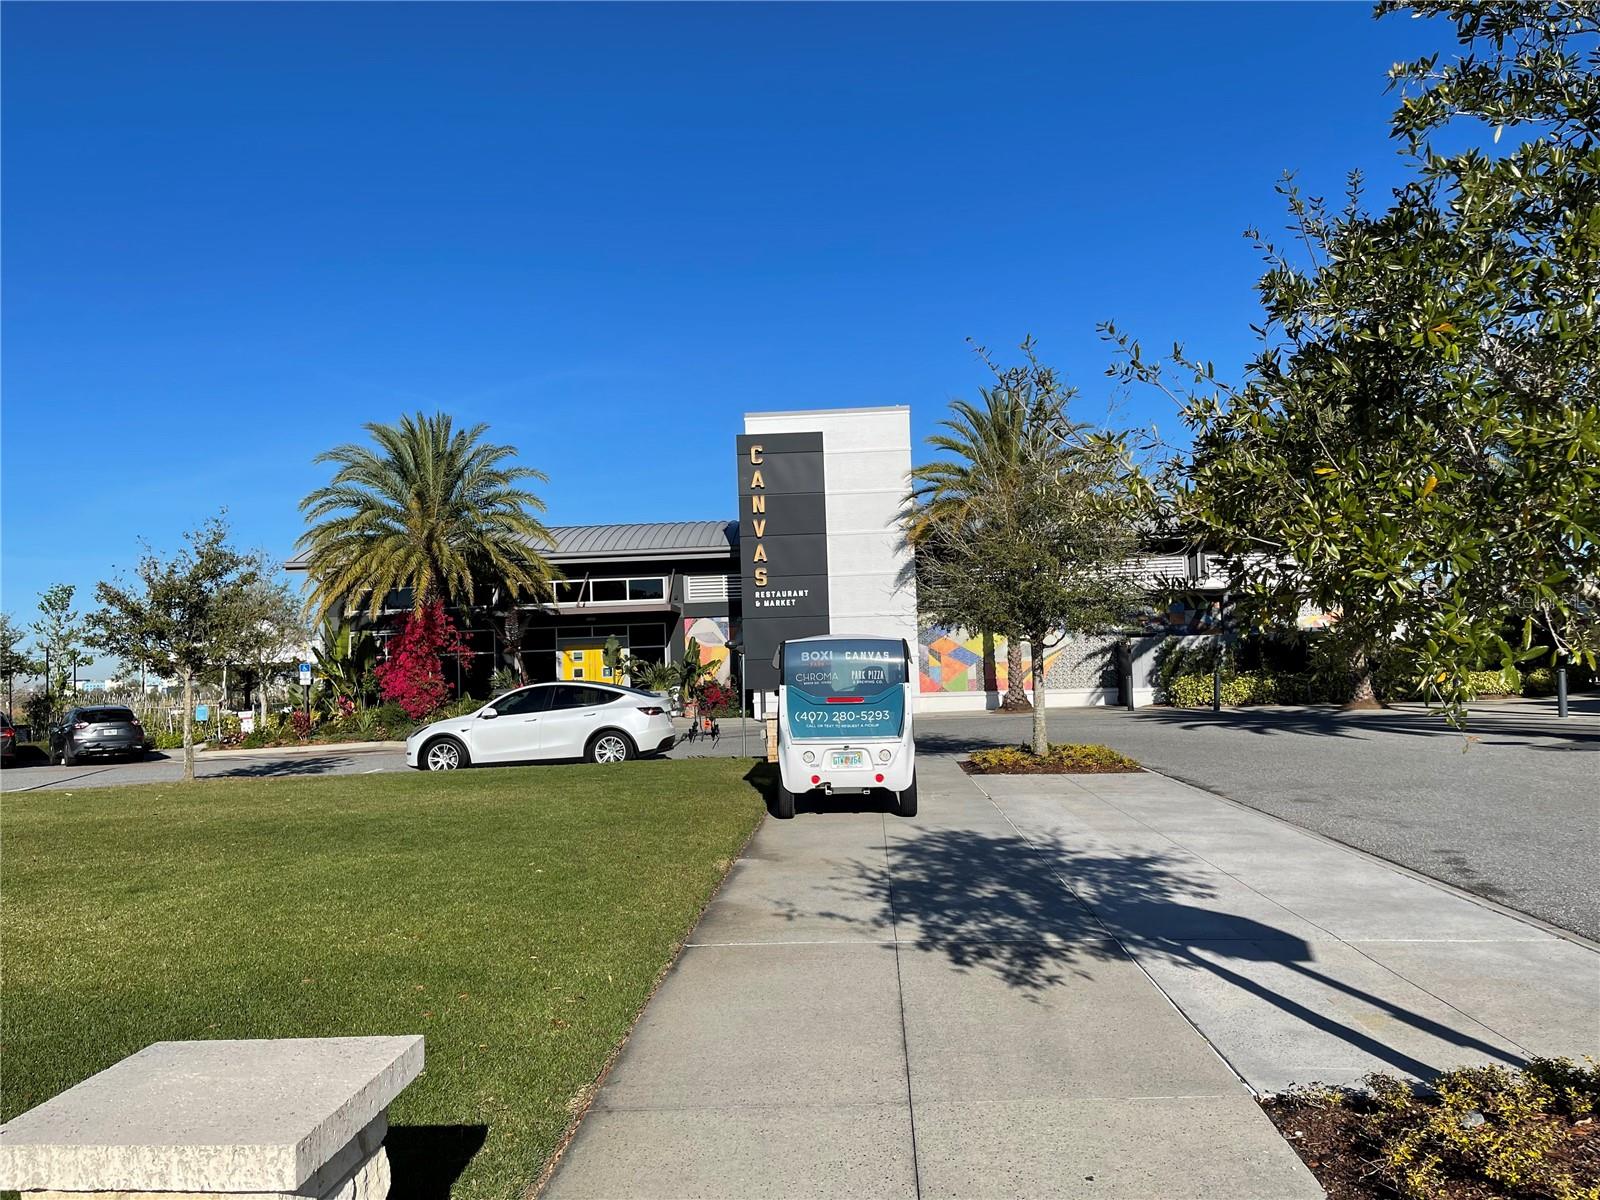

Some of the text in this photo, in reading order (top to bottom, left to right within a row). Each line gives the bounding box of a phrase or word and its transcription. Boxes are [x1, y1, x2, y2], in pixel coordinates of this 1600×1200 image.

[750, 445, 768, 587] CANVAS
[755, 590, 809, 598] RESTAURANT
[763, 599, 796, 607] MARKET
[801, 650, 889, 661] BOXI CANVAS
[795, 672, 839, 682] CHROMA
[851, 670, 885, 680] PARK PIZZA
[794, 710, 890, 723] (407) 280-5293
